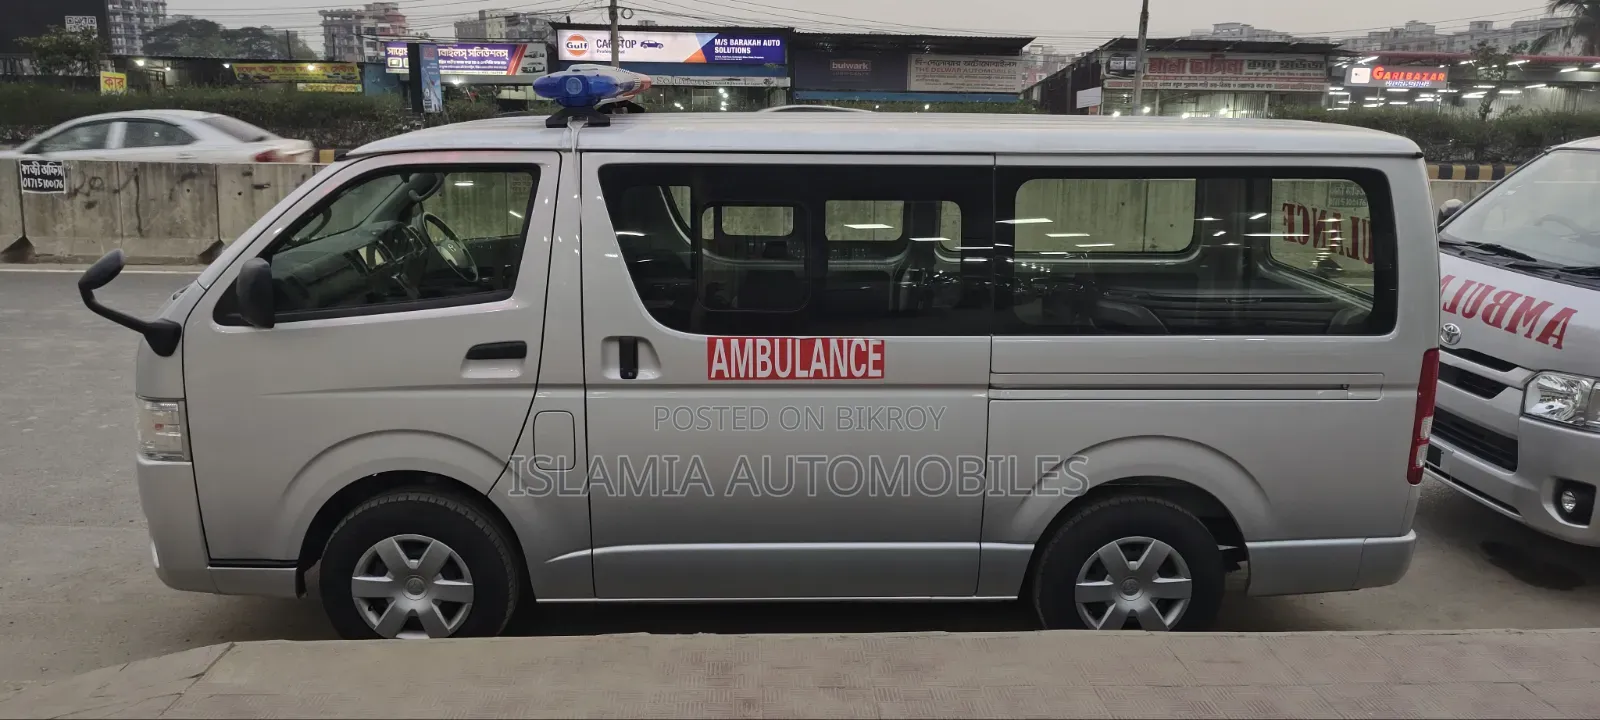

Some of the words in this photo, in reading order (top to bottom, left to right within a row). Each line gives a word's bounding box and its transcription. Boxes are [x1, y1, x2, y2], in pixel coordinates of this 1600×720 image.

[714, 38, 728, 46] M/S
[763, 39, 781, 47] AUTO
[714, 46, 751, 54] SOLUTIONS
[832, 61, 869, 70] bulwark
[21, 161, 41, 176] কাজী
[41, 161, 63, 176] অফিস
[710, 339, 883, 379] AMBULANCE
